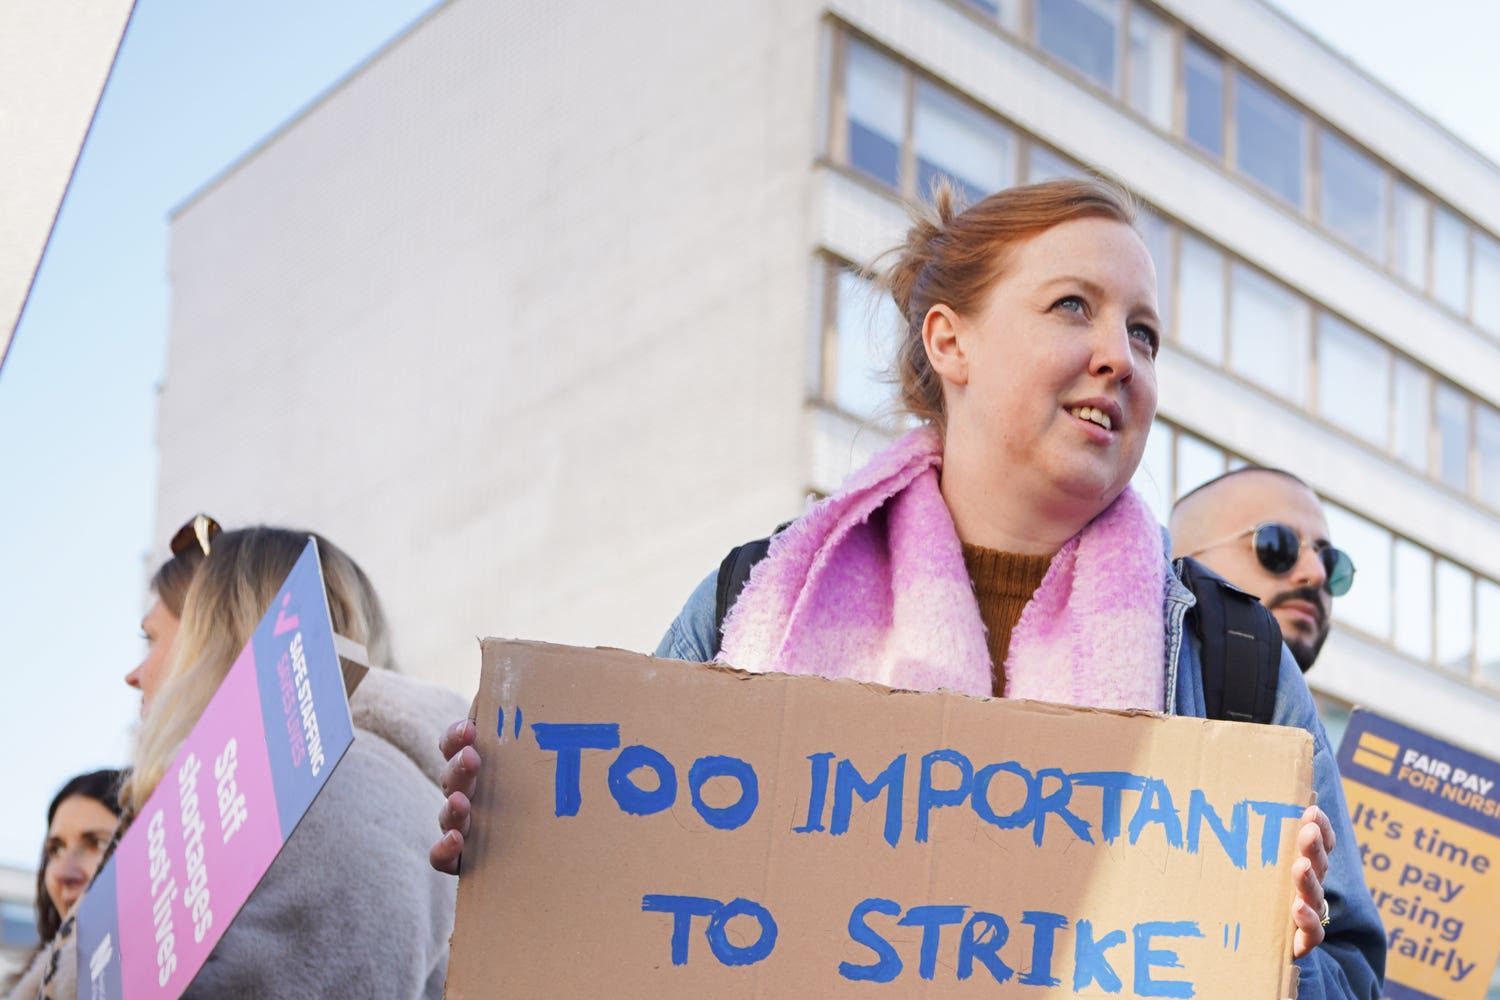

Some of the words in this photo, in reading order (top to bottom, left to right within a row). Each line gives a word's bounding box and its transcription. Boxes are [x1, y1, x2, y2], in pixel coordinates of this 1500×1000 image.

[290, 631, 308, 688] SAFE
[298, 678, 325, 777] STAFFING
[215, 737, 248, 845] Staff
[1397, 765, 1439, 794] FOR
[1402, 748, 1451, 781] FAIR
[1451, 768, 1495, 796] PAY
[794, 750, 1304, 866] IMPORTANT
[1352, 802, 1403, 840] It's
[1413, 827, 1490, 874] time
[148, 809, 171, 897] cost
[178, 752, 213, 945] shortages
[1359, 842, 1391, 872] to
[1398, 863, 1465, 904] pay
[153, 877, 178, 988] lives
[642, 895, 777, 966] TO
[1369, 887, 1465, 943] rsing
[1387, 927, 1477, 982] fairly
